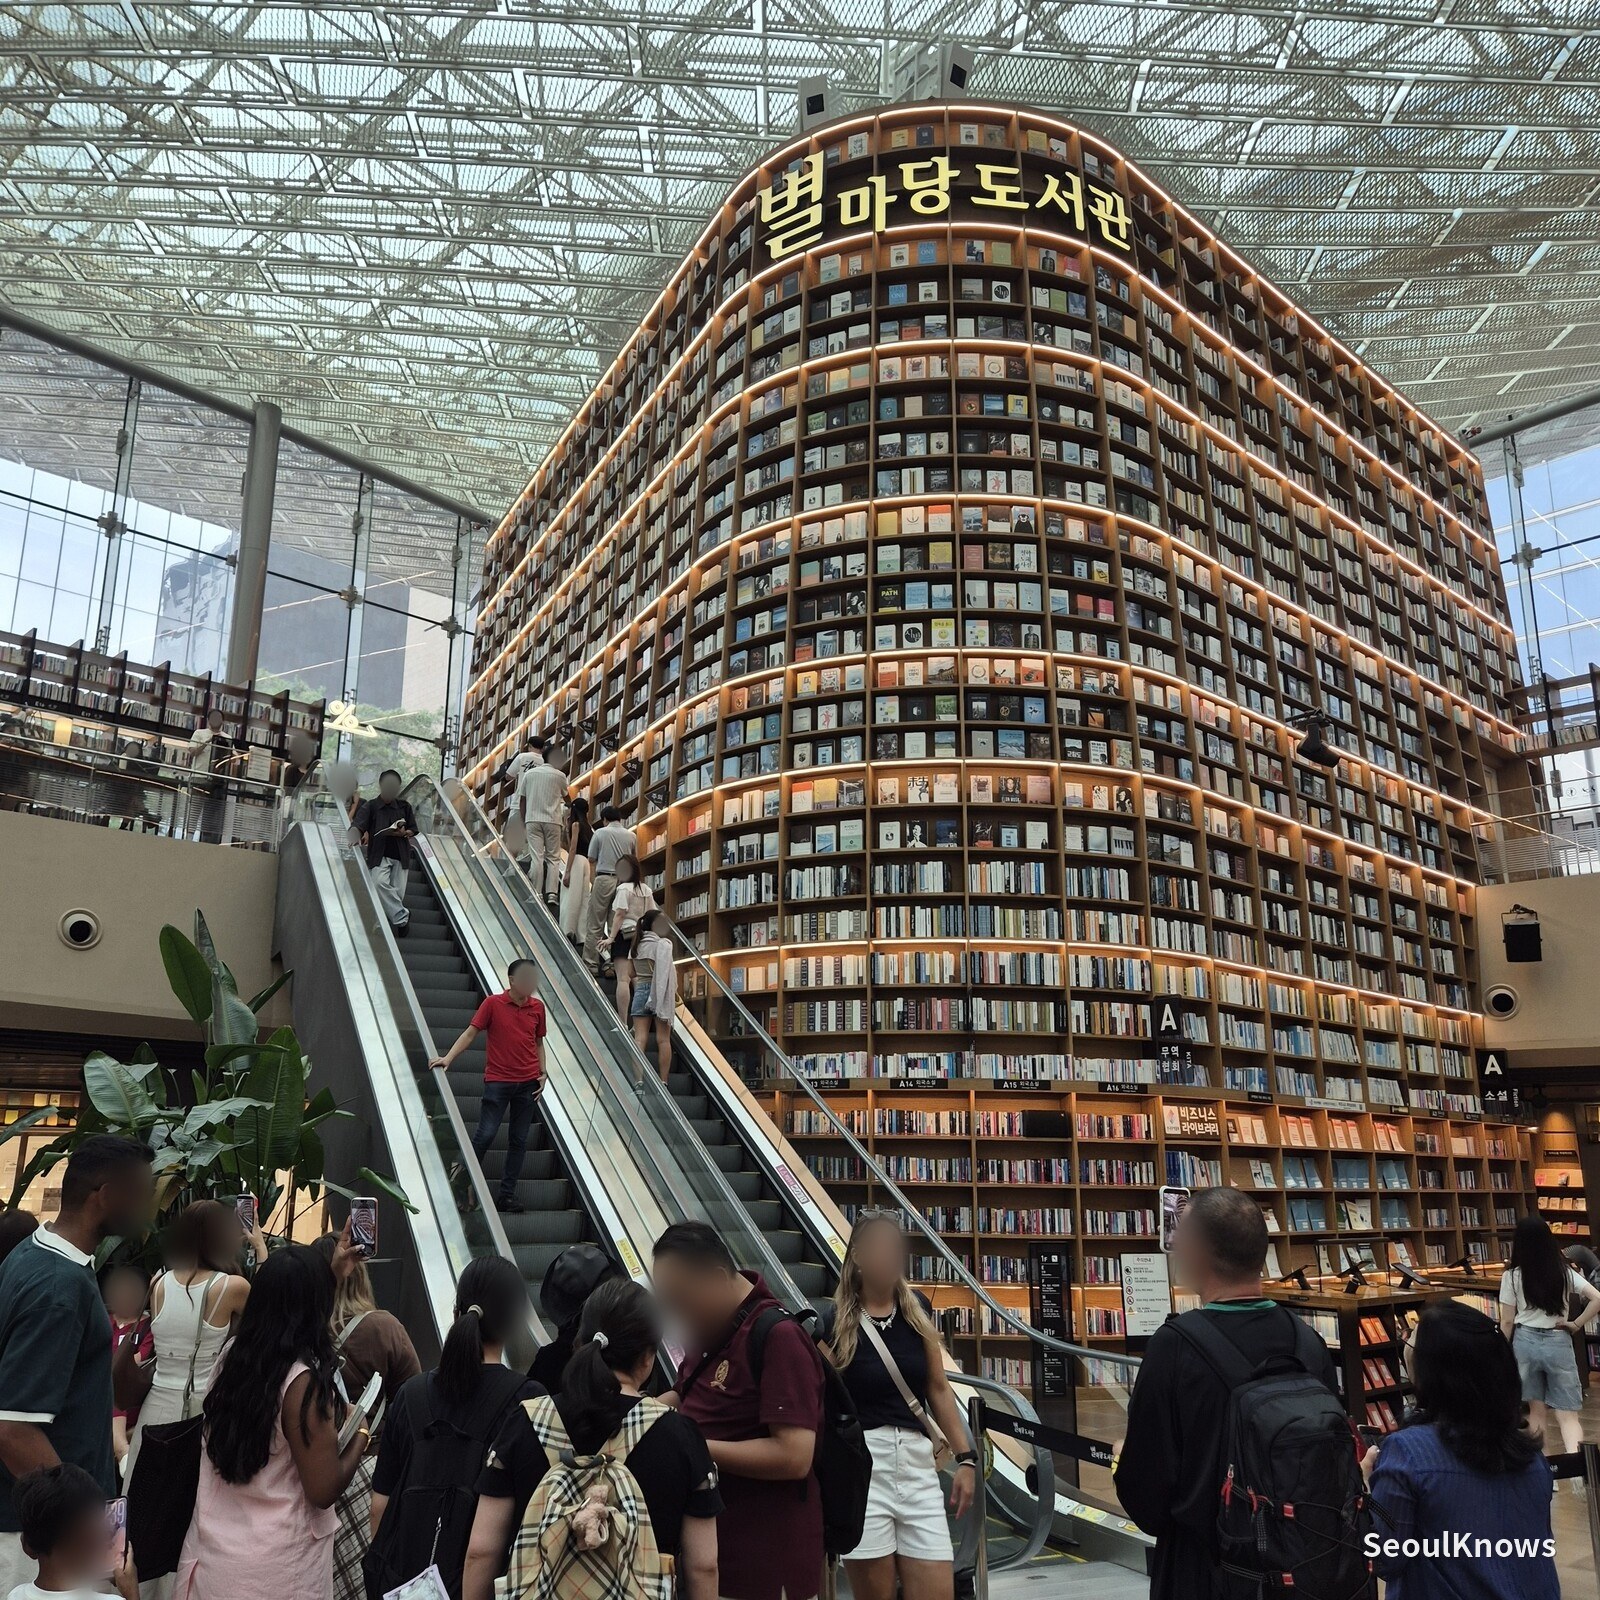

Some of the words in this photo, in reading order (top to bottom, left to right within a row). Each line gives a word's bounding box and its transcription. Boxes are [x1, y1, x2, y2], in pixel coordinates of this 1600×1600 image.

[1160, 1003, 1178, 1032] A
[1161, 1045, 1180, 1058] 무역
[1161, 1060, 1181, 1074] 협회
[1484, 1054, 1503, 1075] A
[899, 1079, 914, 1088] A14
[1003, 1081, 1018, 1089] A15
[1106, 1083, 1120, 1092] A16
[1484, 1090, 1508, 1102] 소설
[1179, 1106, 1217, 1122] 비즈니스
[1181, 1122, 1220, 1136] 라이브러리
